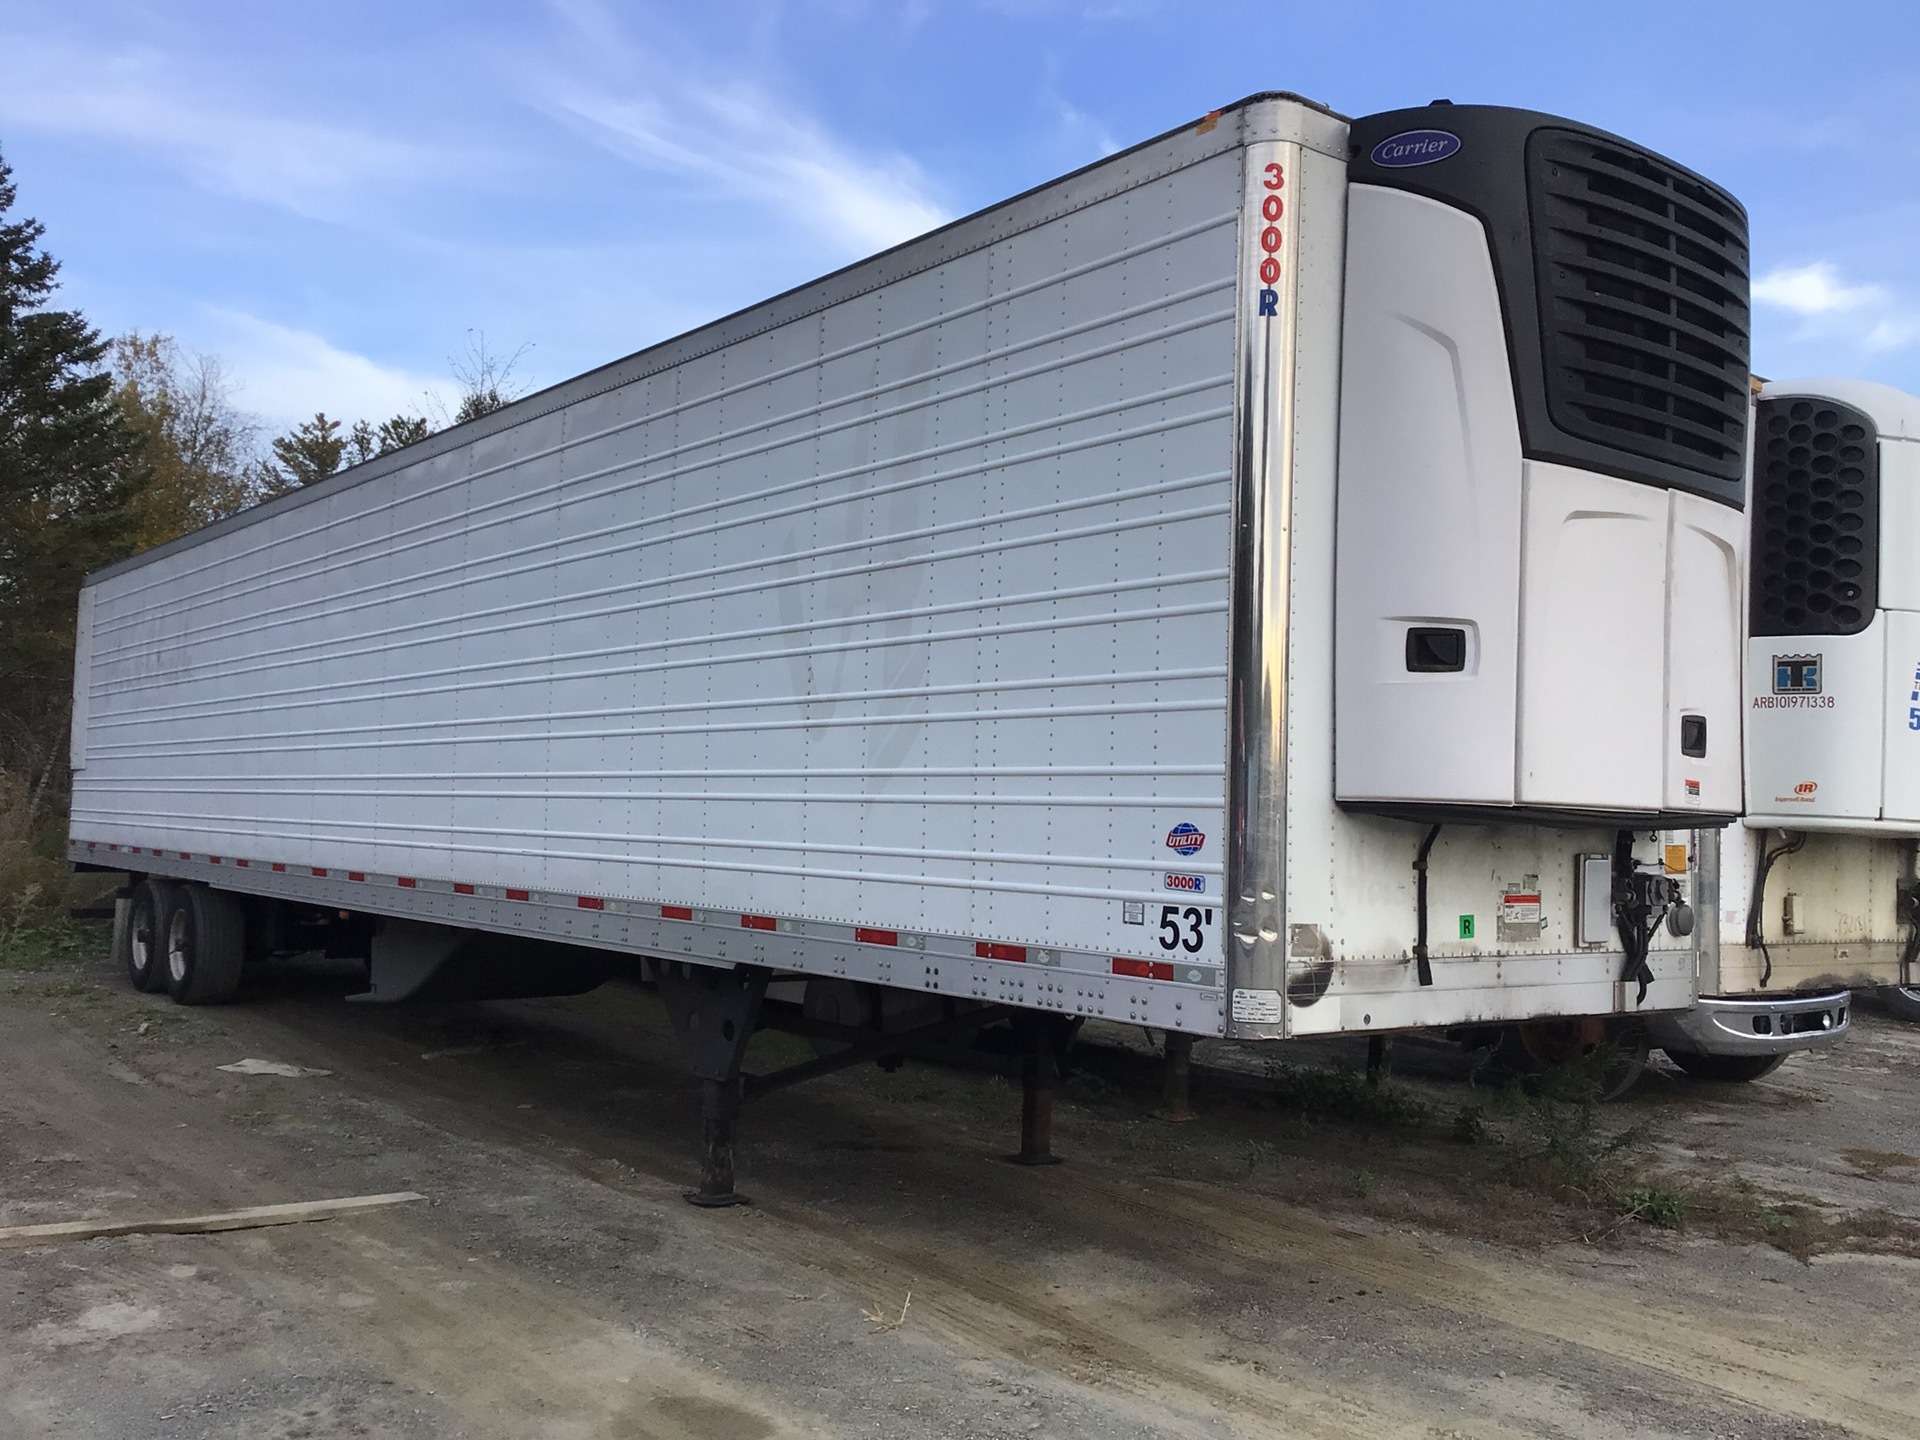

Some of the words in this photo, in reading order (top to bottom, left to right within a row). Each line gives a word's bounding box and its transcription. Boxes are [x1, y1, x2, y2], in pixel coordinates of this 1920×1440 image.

[1382, 139, 1448, 159] Carrier
[1259, 163, 1284, 316] 3000R
[1752, 696, 1835, 709] ARB101971338
[1168, 834, 1204, 847] UTILITY
[1166, 874, 1202, 891] 3000R
[1158, 905, 1213, 954] 53'
[1463, 918, 1471, 934] R
